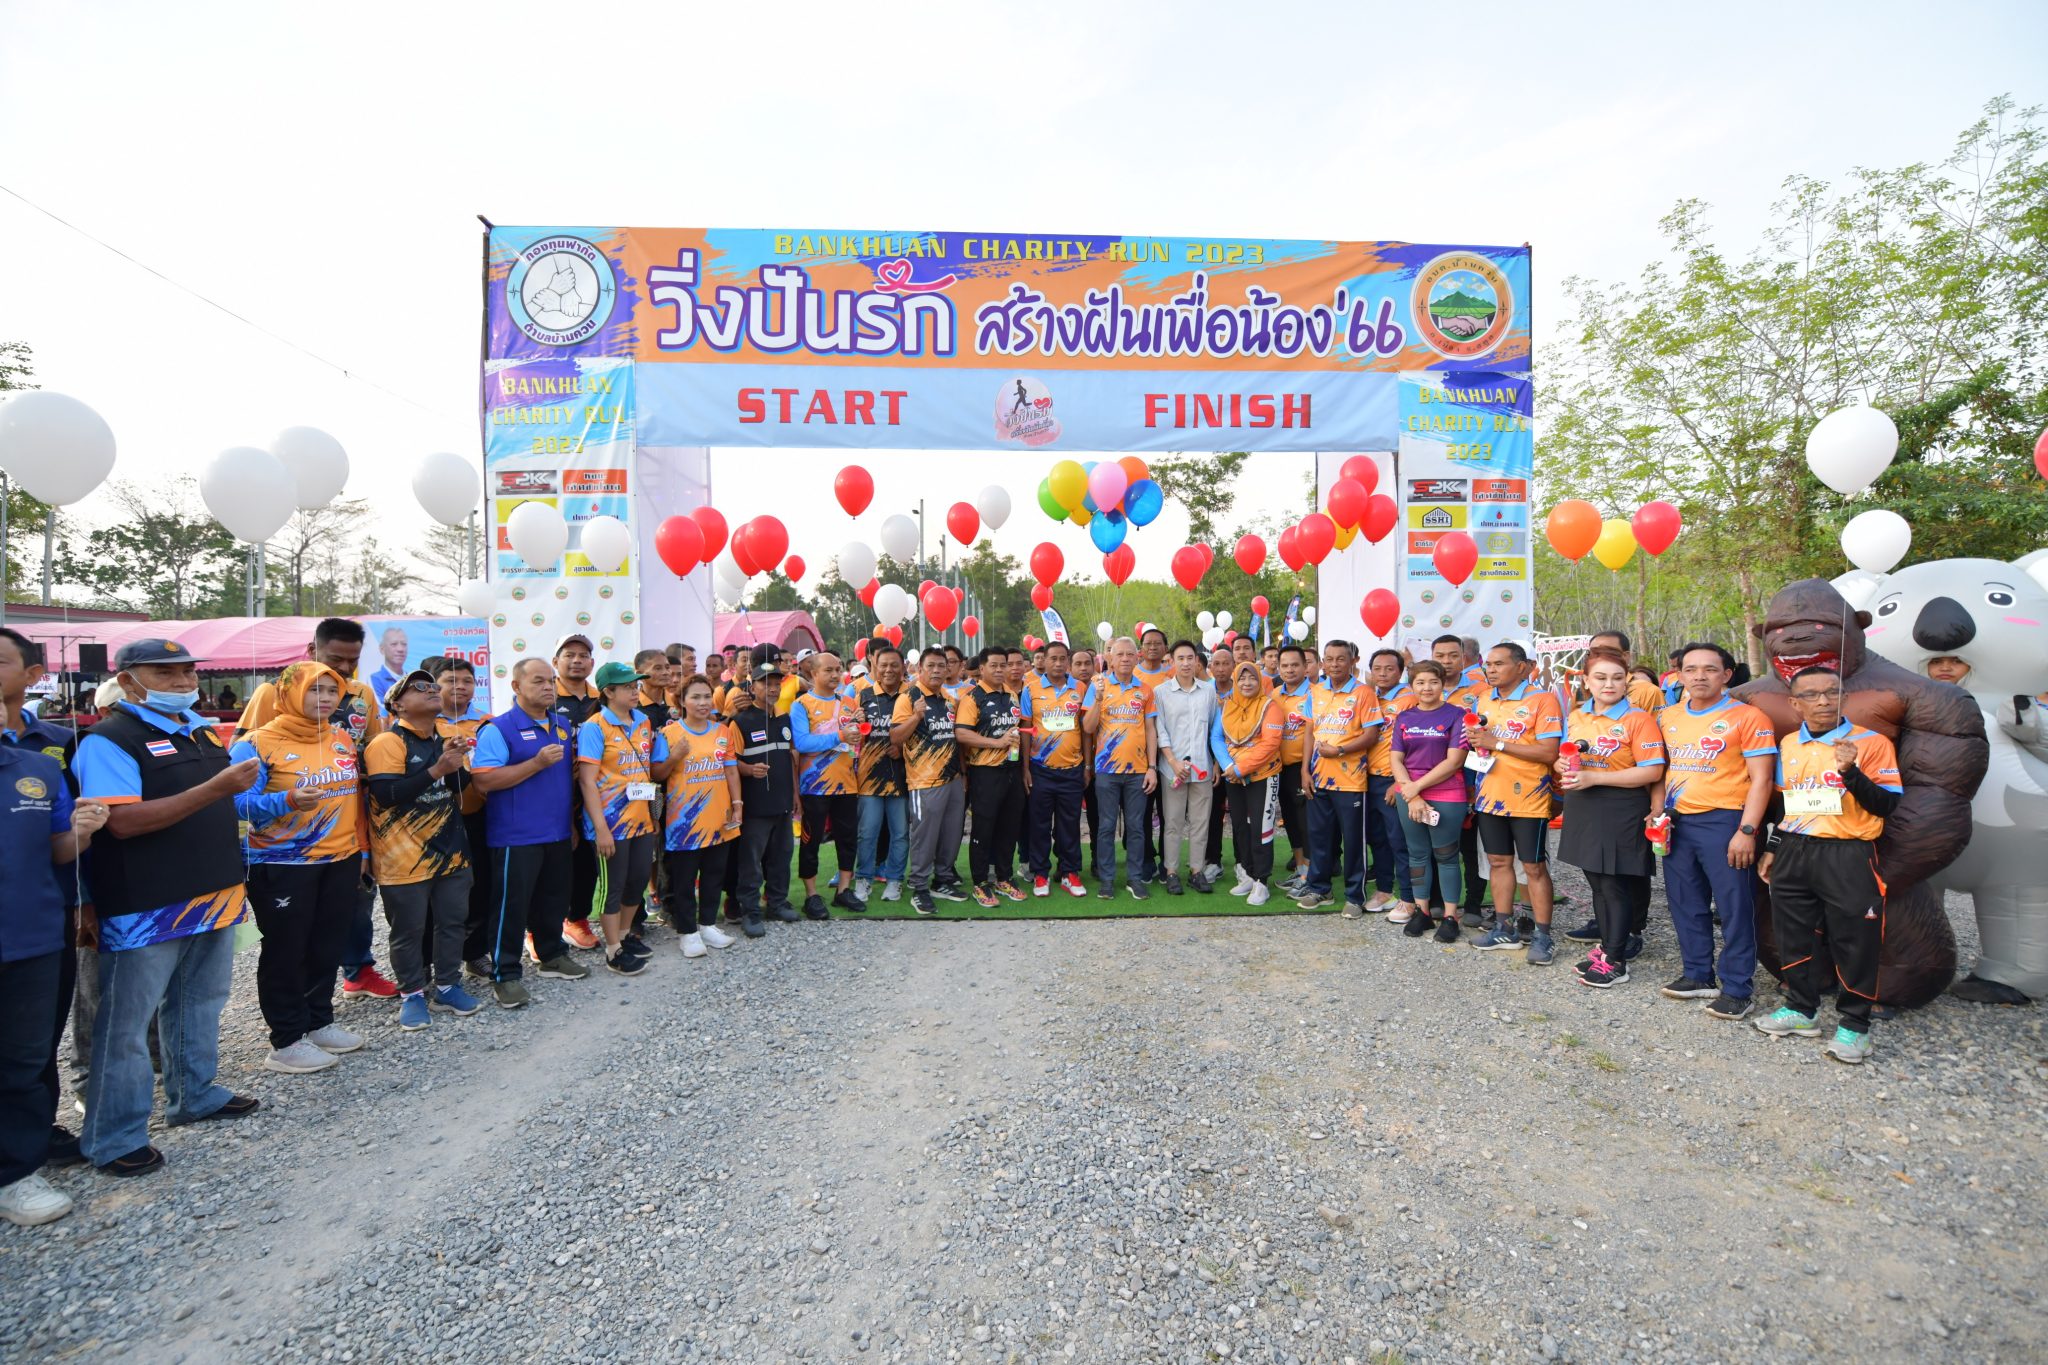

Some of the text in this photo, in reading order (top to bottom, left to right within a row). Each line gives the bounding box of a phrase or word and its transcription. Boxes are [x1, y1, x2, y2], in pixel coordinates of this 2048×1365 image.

[774, 234, 1265, 265] BANKHUAN CHARITY RUN 2023
[646, 248, 956, 355] วิ่งปันรัก
[523, 319, 597, 343] ตำบลบ้านควน
[504, 376, 612, 396] BANKHUAN
[1419, 387, 1518, 404] BANKHUAN
[493, 406, 625, 425] CHARITY RUN
[738, 388, 908, 425] START
[1144, 394, 1312, 428] FINISH
[1408, 415, 1526, 432] CHARITY RUN
[532, 437, 584, 454] 2023
[1446, 443, 1493, 460] 2023
[444, 627, 488, 636] ชาวจังหวัด
[1808, 799, 1822, 807] VIP
